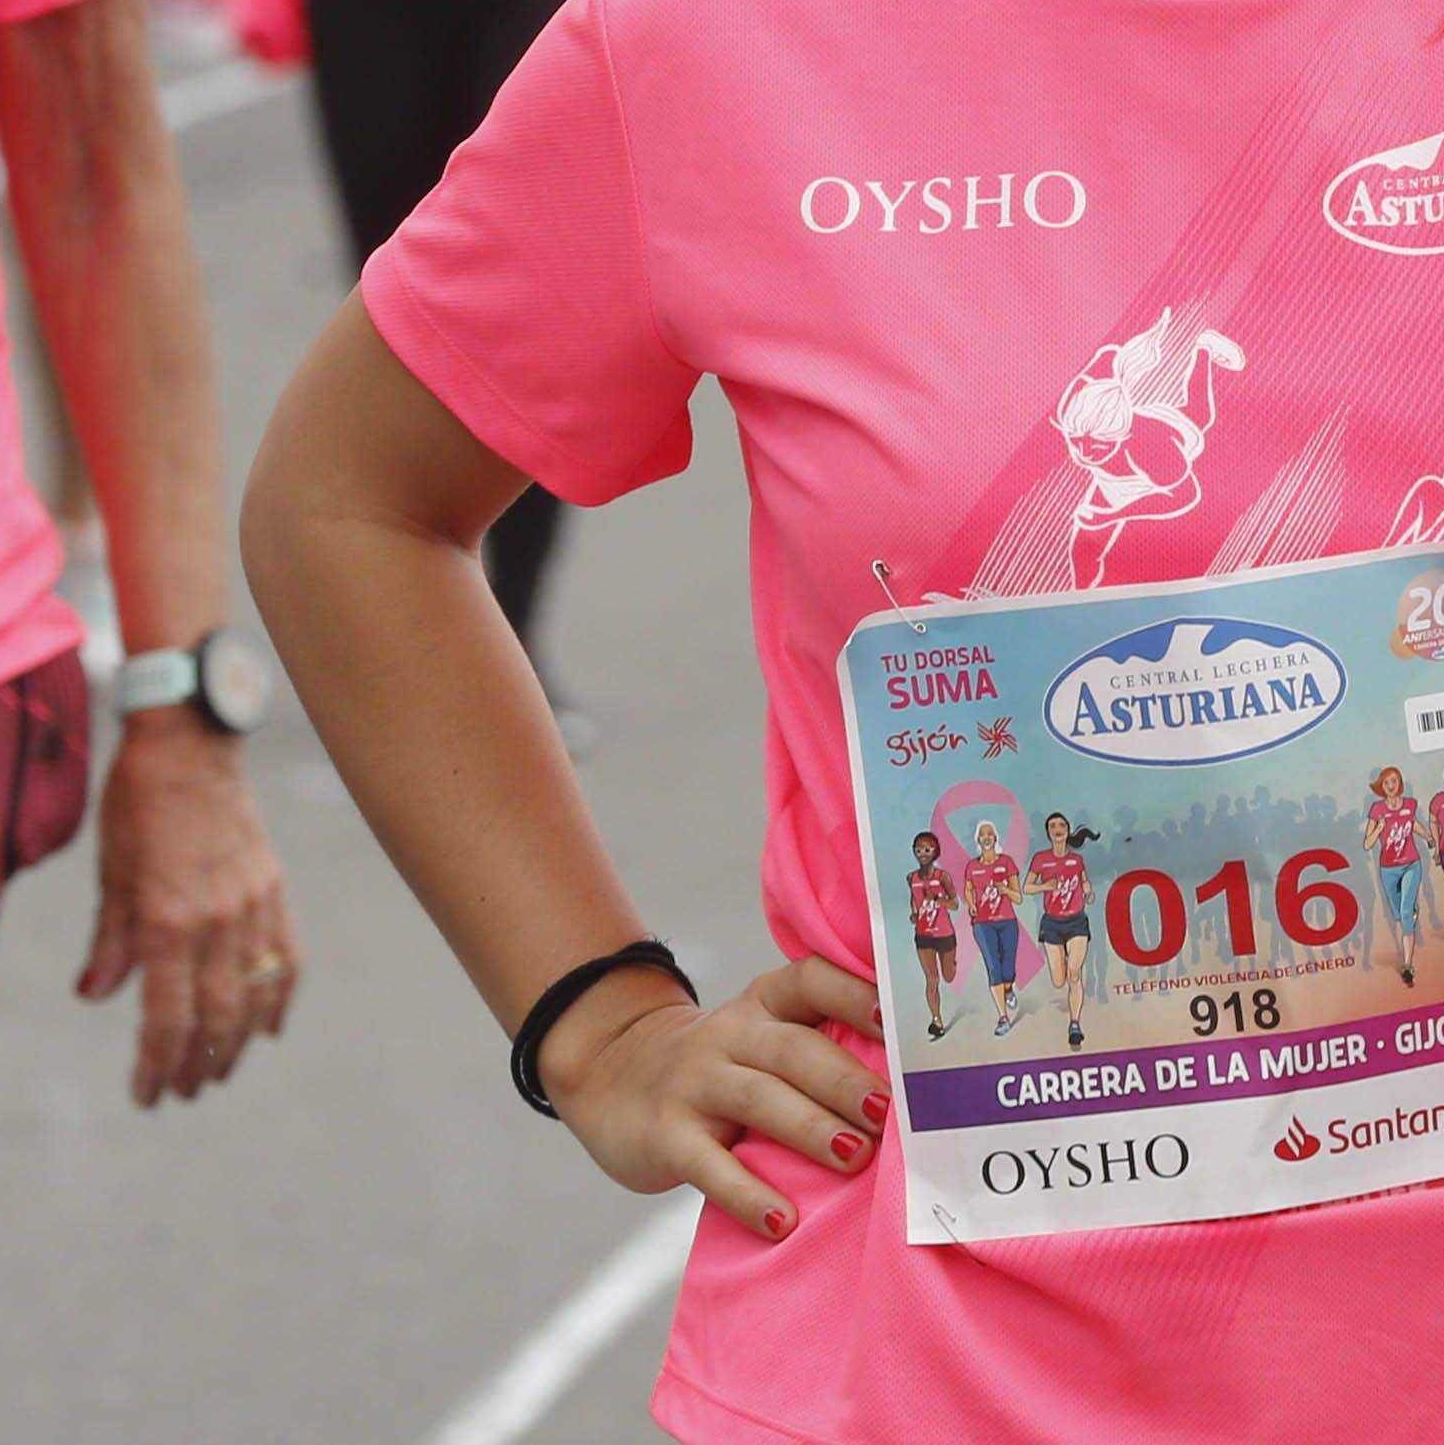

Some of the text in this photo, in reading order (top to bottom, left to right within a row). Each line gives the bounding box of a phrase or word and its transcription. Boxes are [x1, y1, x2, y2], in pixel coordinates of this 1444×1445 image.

[800, 170, 1087, 234] OYSHO
[880, 645, 996, 673] TU DORSAL
[1109, 651, 1311, 690] CENTRAL LECHERA
[886, 667, 999, 710] SUMA
[1069, 672, 1328, 737] ASTURIANA
[1105, 847, 1359, 967] 016
[1114, 955, 1356, 996] TELÉFONO VIOLENCIA DE GÉNERO
[1189, 987, 1282, 1037] 918
[996, 1061, 1146, 1108] CARRERA
[1155, 1055, 1198, 1092] DE
[1206, 1051, 1251, 1086] LA
[1259, 1034, 1368, 1081] MUJER
[981, 1132, 1191, 1196] OYSHO
